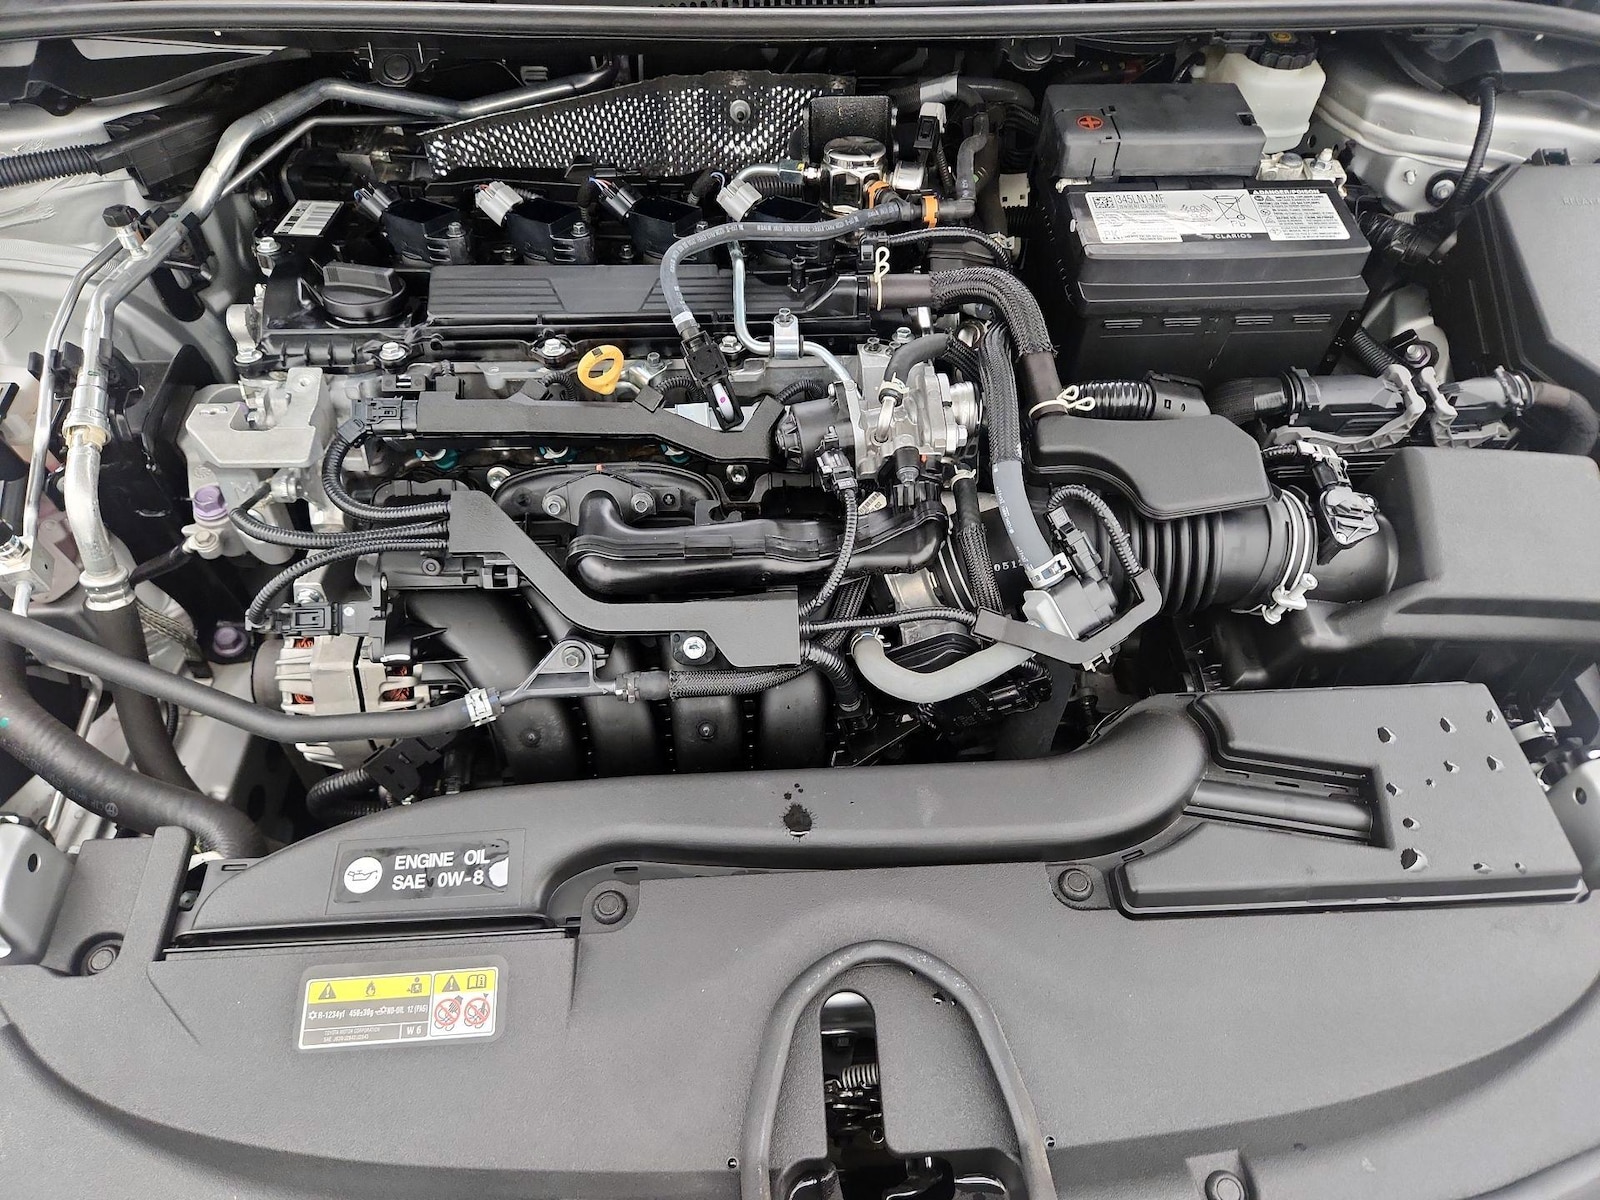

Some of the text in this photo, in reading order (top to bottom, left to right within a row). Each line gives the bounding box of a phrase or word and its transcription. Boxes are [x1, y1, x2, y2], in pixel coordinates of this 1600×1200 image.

[394, 848, 491, 871] ENGINE OIL
[391, 869, 485, 891] SAE 0W-8
[406, 1025, 422, 1036] W 6
